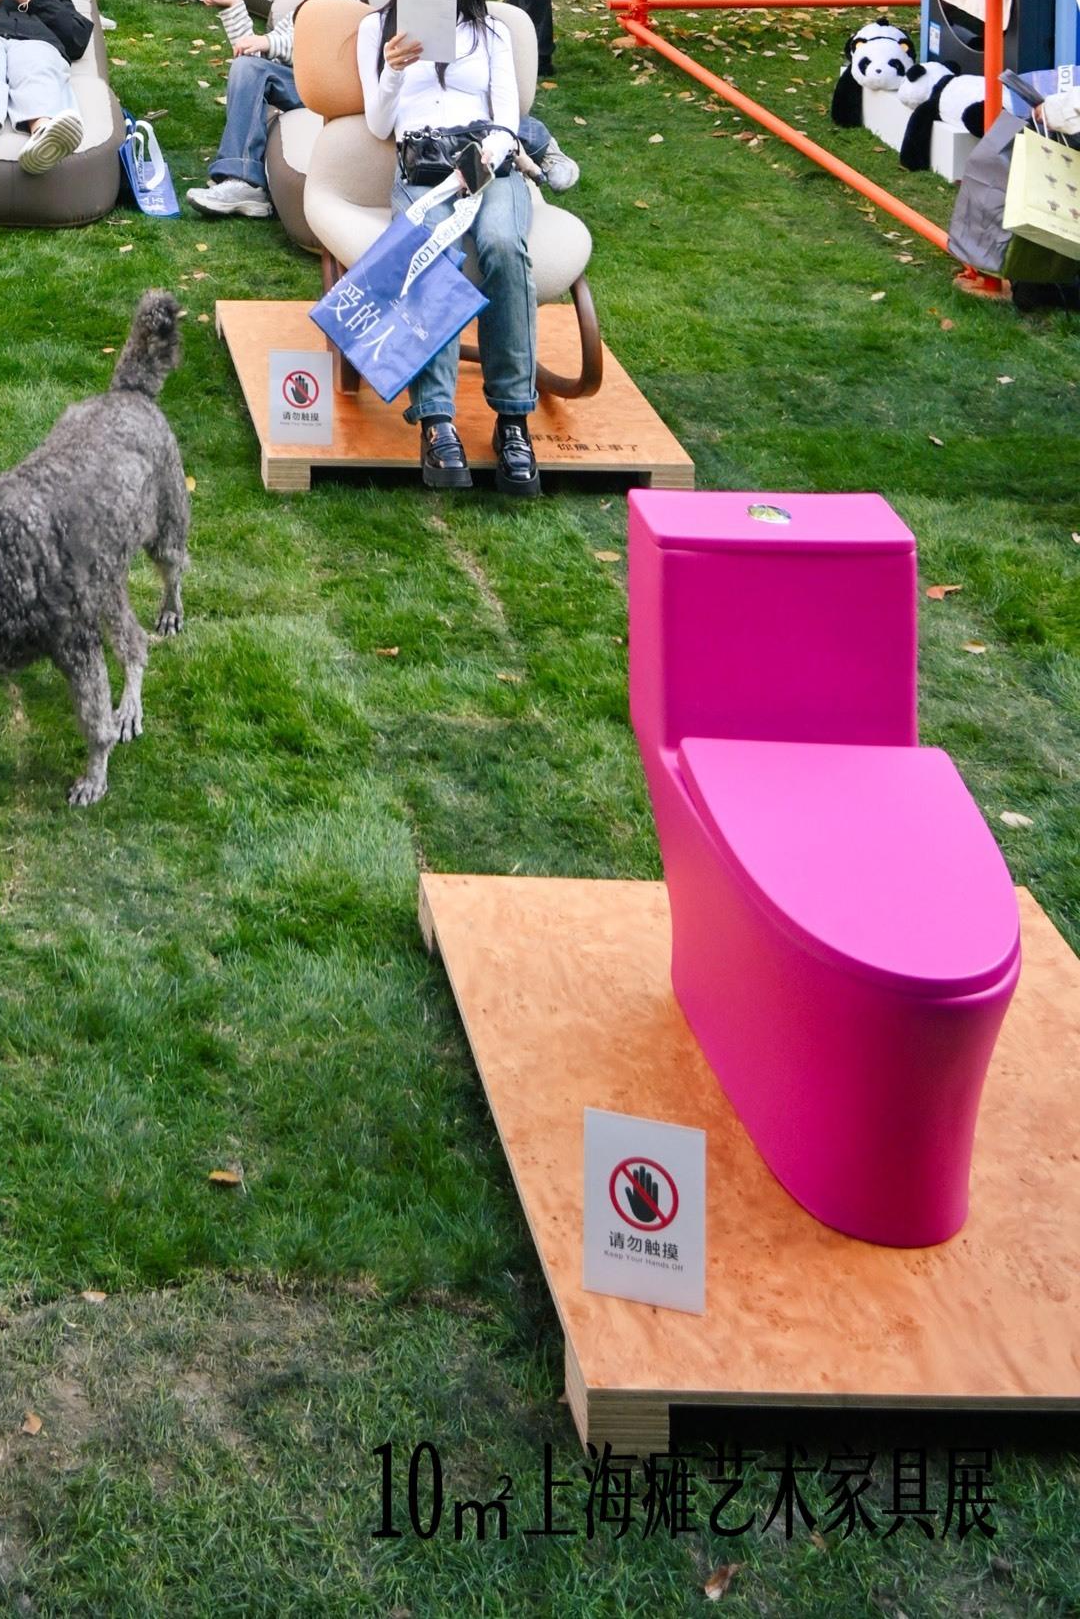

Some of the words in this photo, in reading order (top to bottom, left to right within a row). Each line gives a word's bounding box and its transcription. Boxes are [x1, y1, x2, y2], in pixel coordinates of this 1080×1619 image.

[326, 277, 396, 362] 受的人
[282, 411, 319, 421] 请勿触摸
[608, 1230, 679, 1261] 请勿触摸
[625, 1253, 643, 1264] Your
[645, 1258, 670, 1269] Hands
